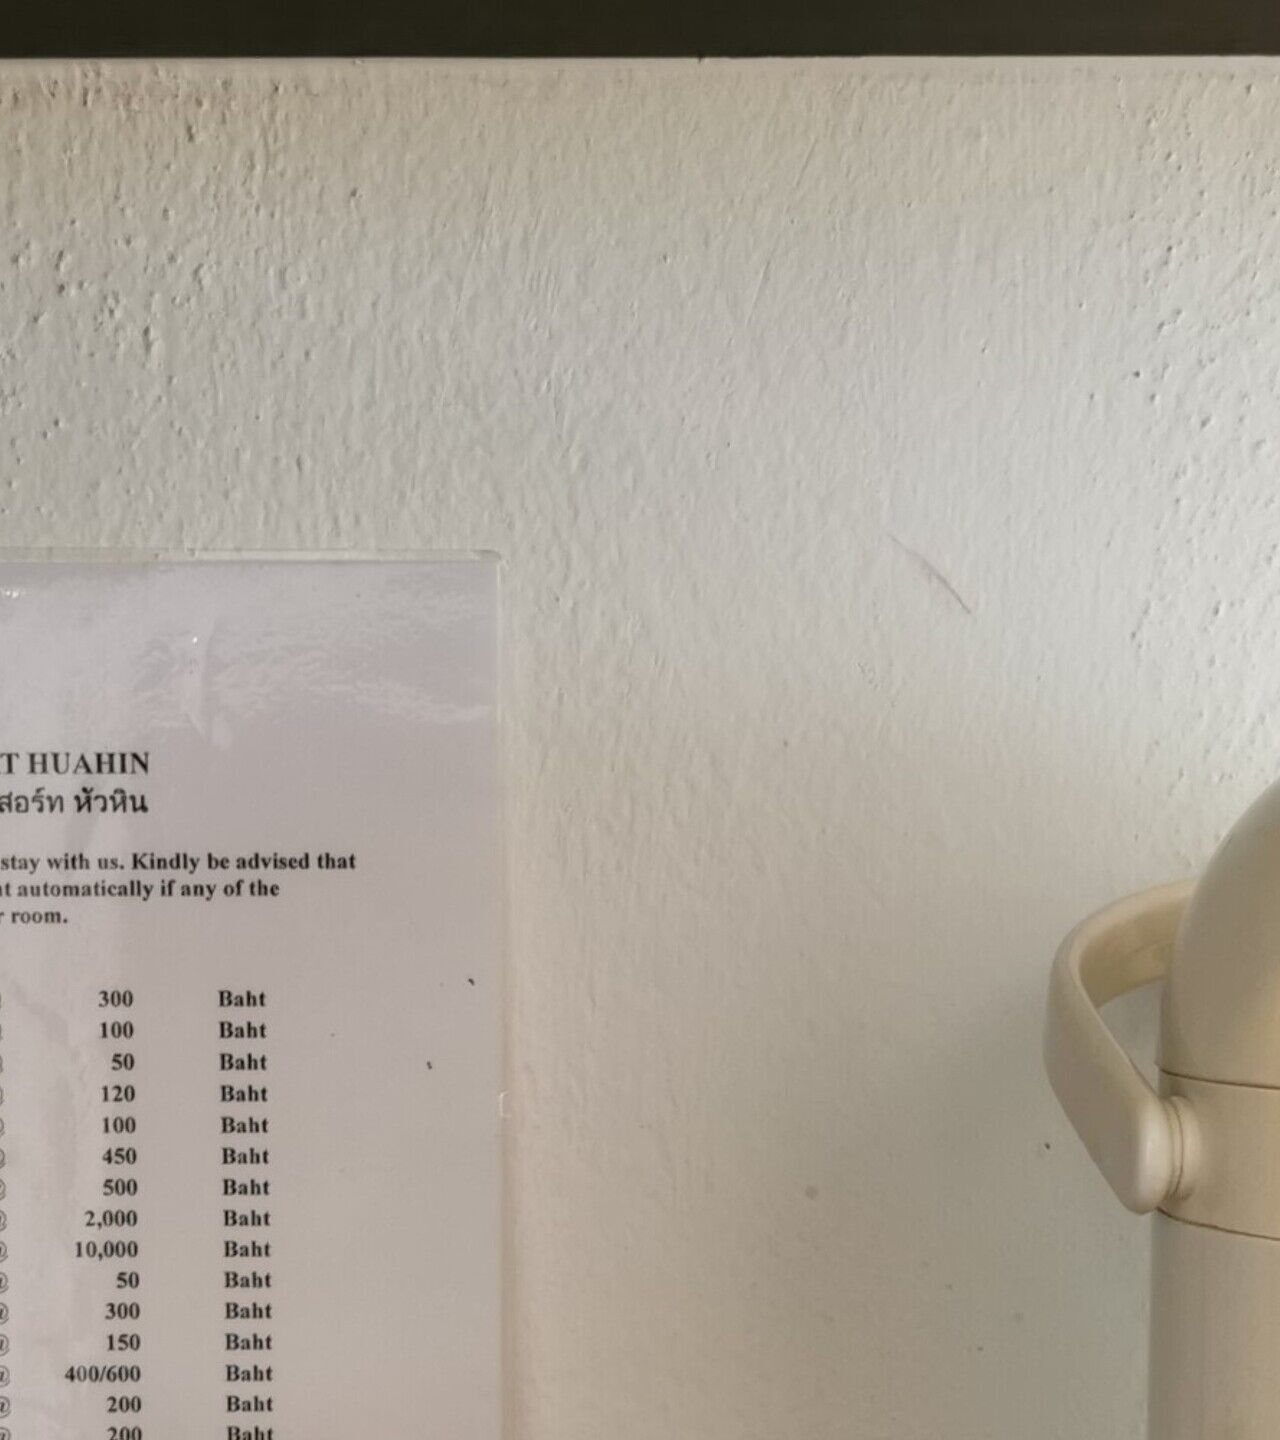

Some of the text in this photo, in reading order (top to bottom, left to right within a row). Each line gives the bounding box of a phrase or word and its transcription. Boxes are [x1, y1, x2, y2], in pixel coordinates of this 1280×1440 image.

[28, 751, 149, 774] HUAHIN
[74, 786, 149, 813] หัวหิน
[0, 855, 40, 875] stay
[47, 852, 90, 871] with
[98, 858, 124, 870] us.
[132, 852, 200, 874] Kindly
[207, 852, 230, 870] be
[236, 852, 310, 870] advised
[317, 852, 356, 870] that
[17, 880, 154, 902] automatically
[161, 879, 176, 897] if
[181, 884, 216, 901] any
[223, 879, 244, 897] of
[249, 879, 279, 897] the
[11, 911, 68, 924] room.
[98, 990, 134, 1008] 300
[218, 990, 266, 1007] Baht
[101, 1021, 134, 1039] 100
[112, 1053, 267, 1071] 50 Baht
[102, 1085, 135, 1102] 120
[103, 1116, 136, 1134] 100
[102, 1147, 269, 1165] 450 Baht
[103, 1178, 138, 1196] 500
[85, 1209, 138, 1230] 2,000
[76, 1240, 271, 1261] 10,000 Baht
[116, 1271, 140, 1289] 50
[105, 1302, 141, 1320] 300
[107, 1333, 141, 1351] 150
[64, 1364, 273, 1383] 400/600 Baht
[107, 1396, 142, 1413] 200
